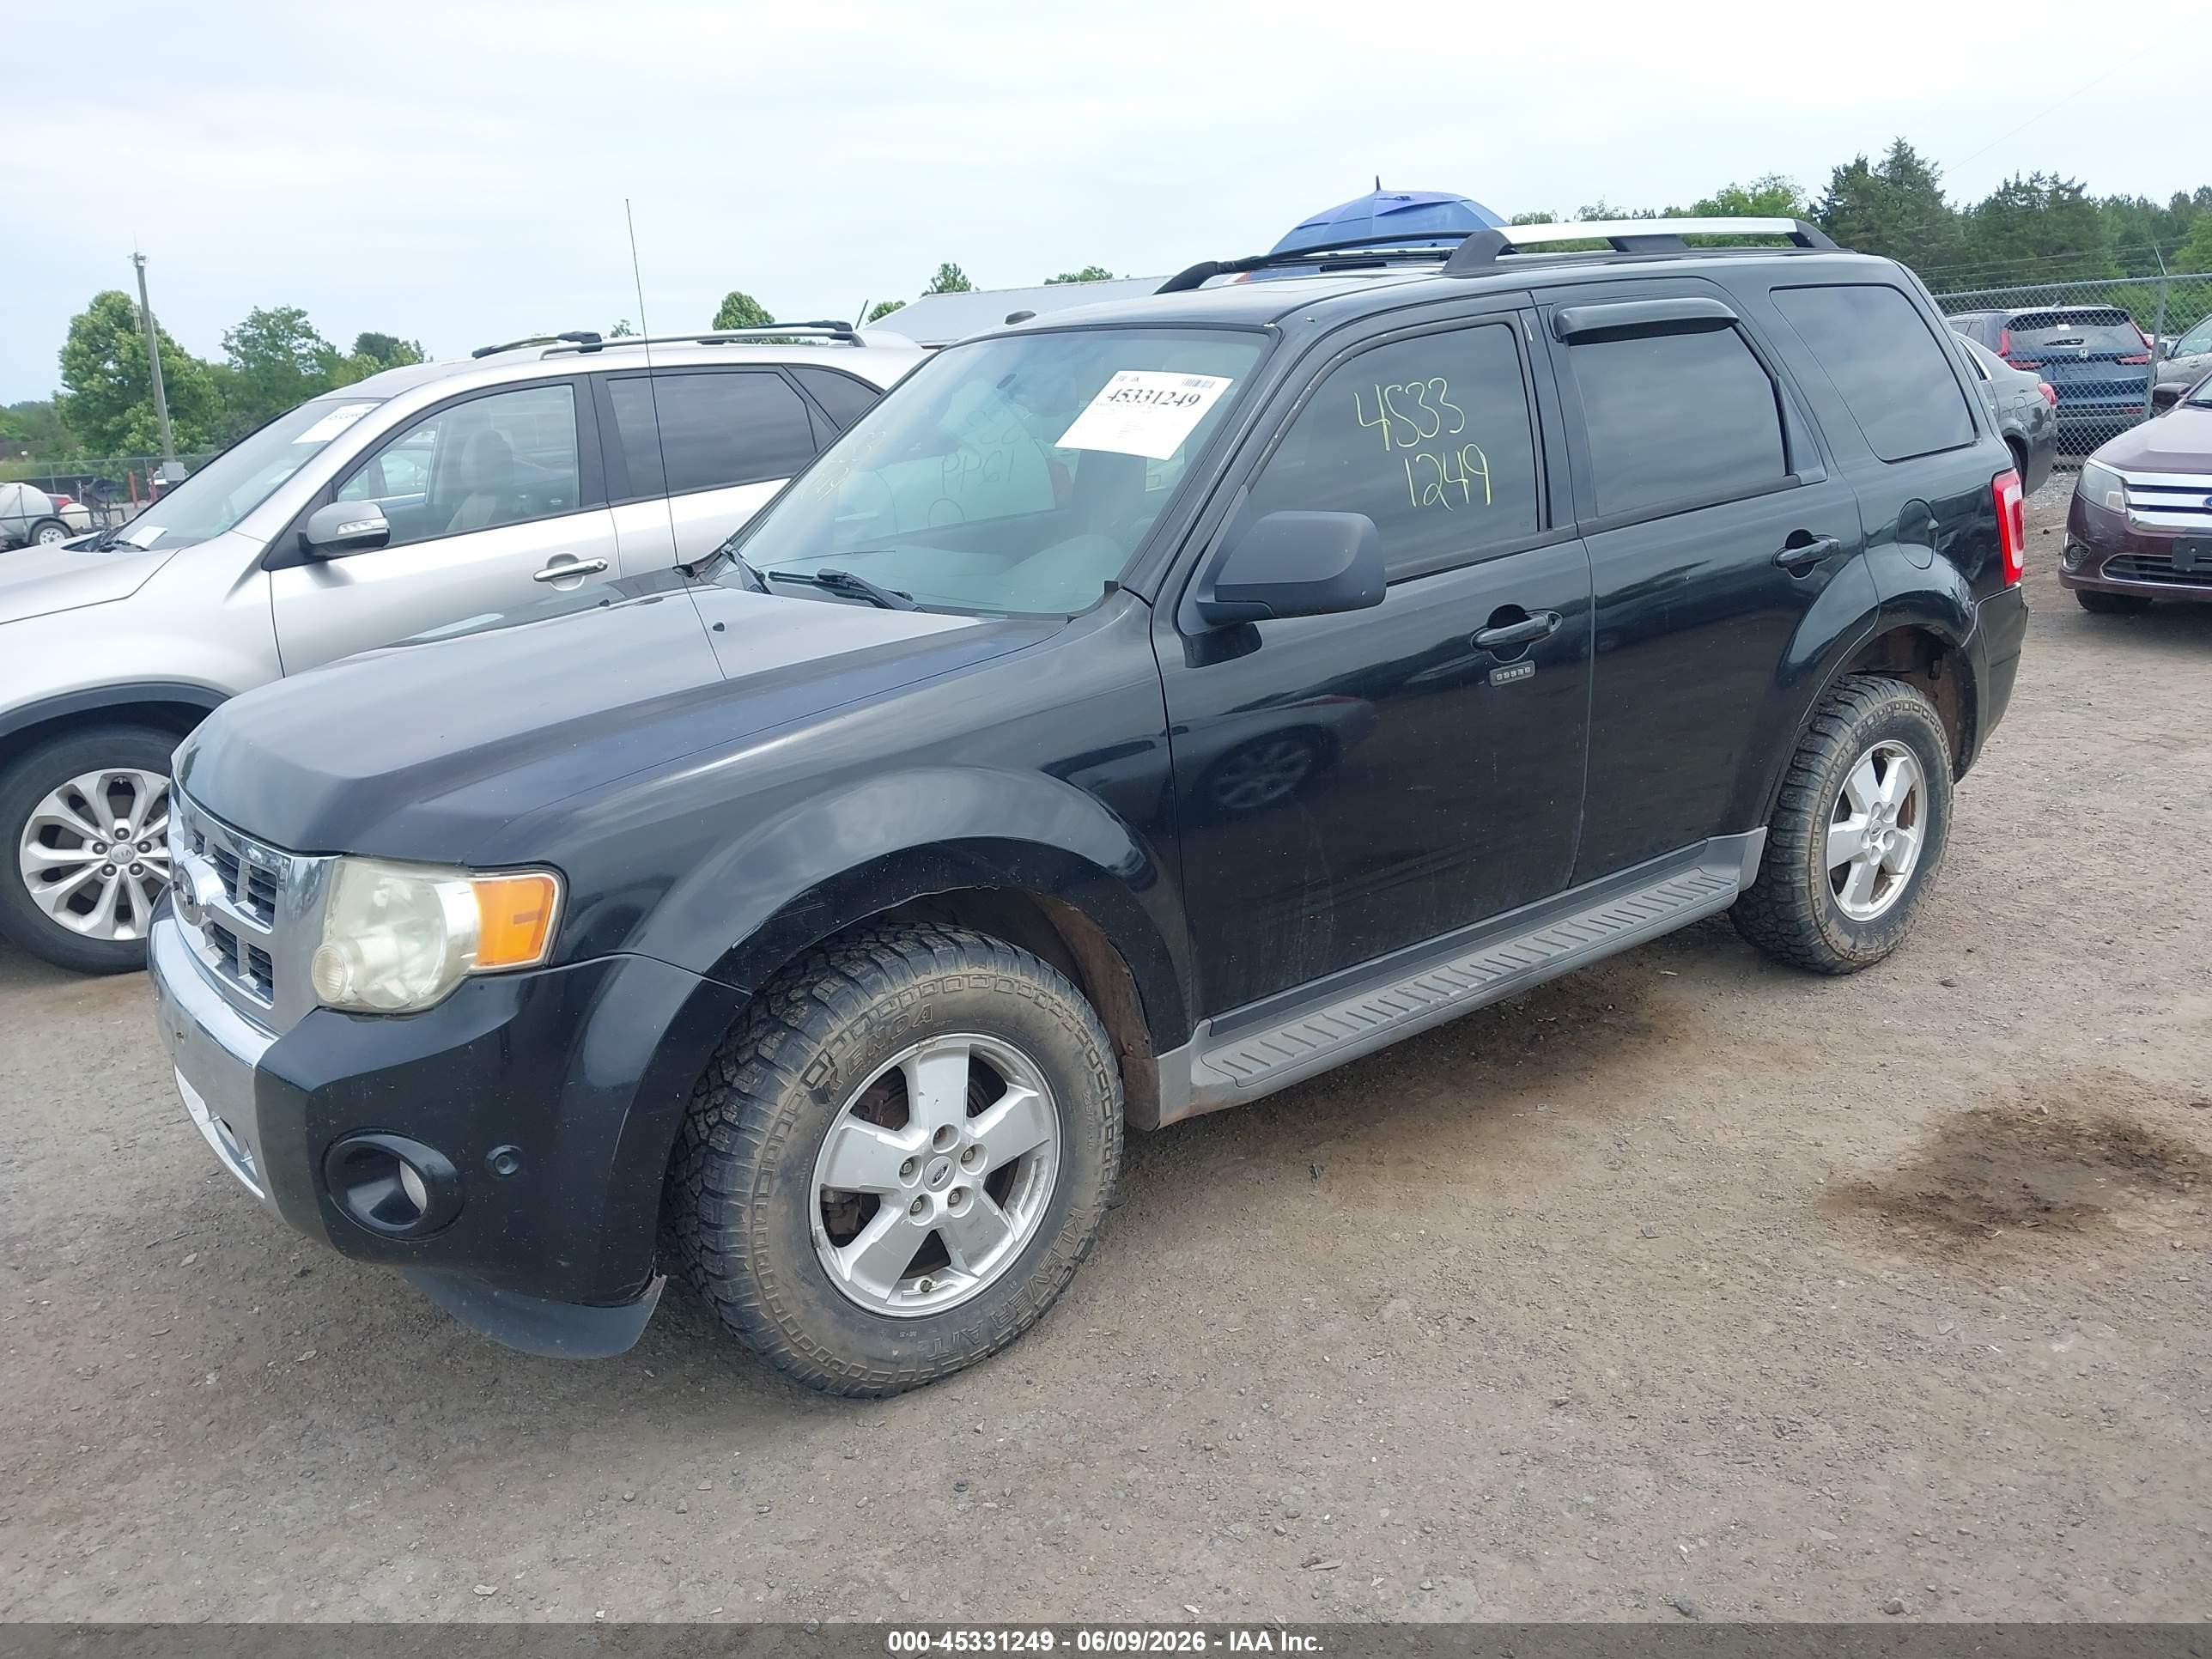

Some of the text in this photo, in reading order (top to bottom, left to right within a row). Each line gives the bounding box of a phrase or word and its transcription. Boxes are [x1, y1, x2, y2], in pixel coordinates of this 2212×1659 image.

[1107, 387, 1201, 408] 45331249
[1354, 377, 1465, 451] 4533
[1403, 443, 1491, 511] 1249
[817, 1003, 933, 1101] KENDA
[989, 1207, 1086, 1330] KLEVER
